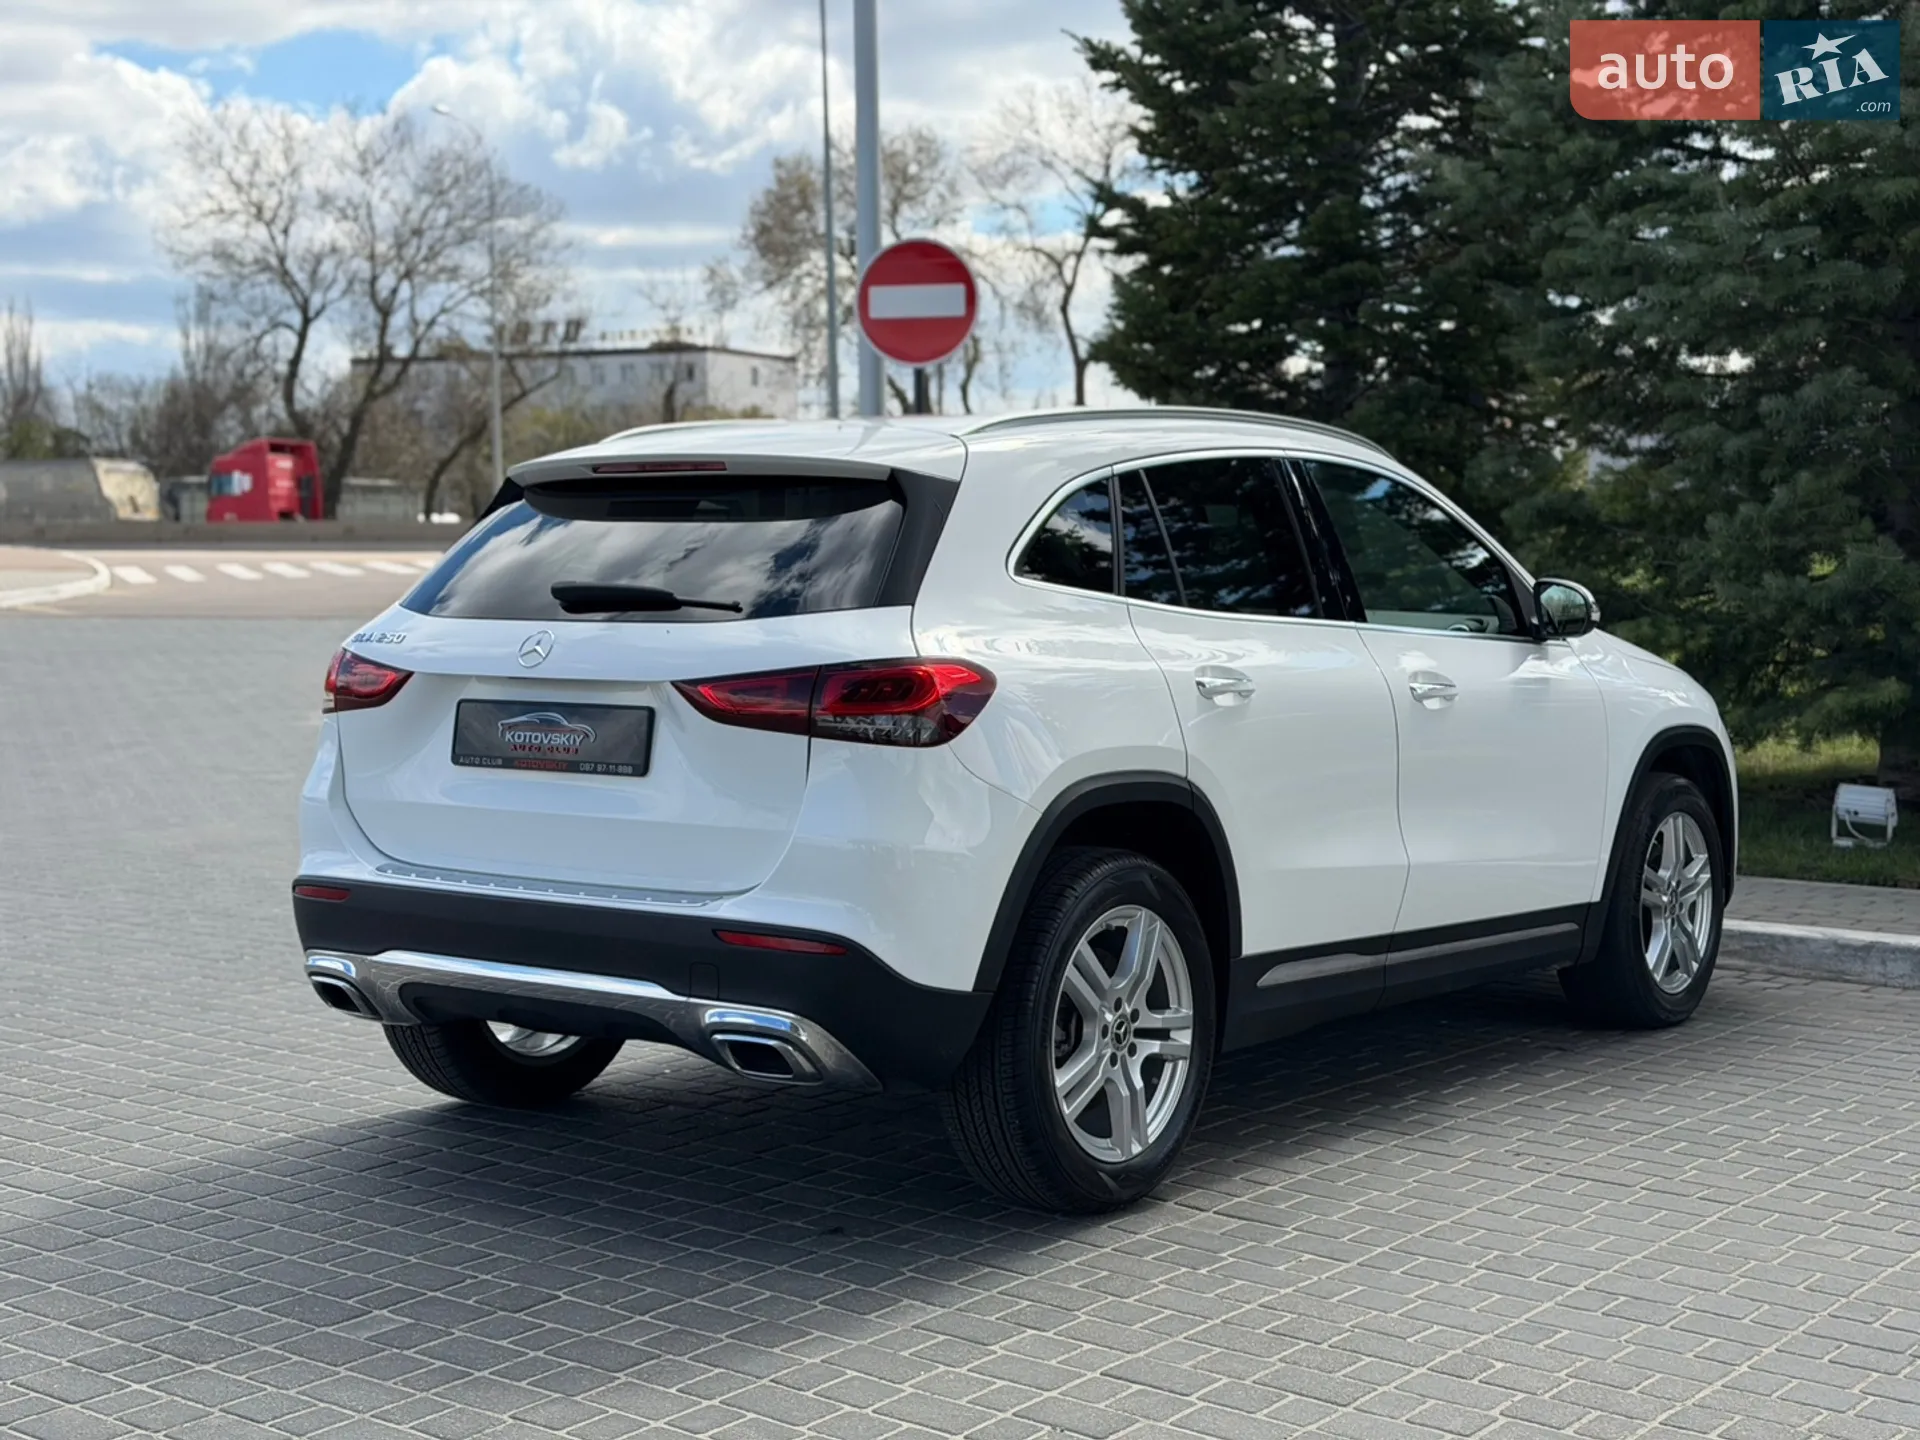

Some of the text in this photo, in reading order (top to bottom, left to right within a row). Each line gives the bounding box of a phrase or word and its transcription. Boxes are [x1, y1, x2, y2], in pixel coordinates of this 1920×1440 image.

[375, 632, 407, 645] 250
[505, 731, 584, 746] KOTOVSKIY
[459, 756, 481, 765] AUTO
[481, 757, 503, 766] CLUB
